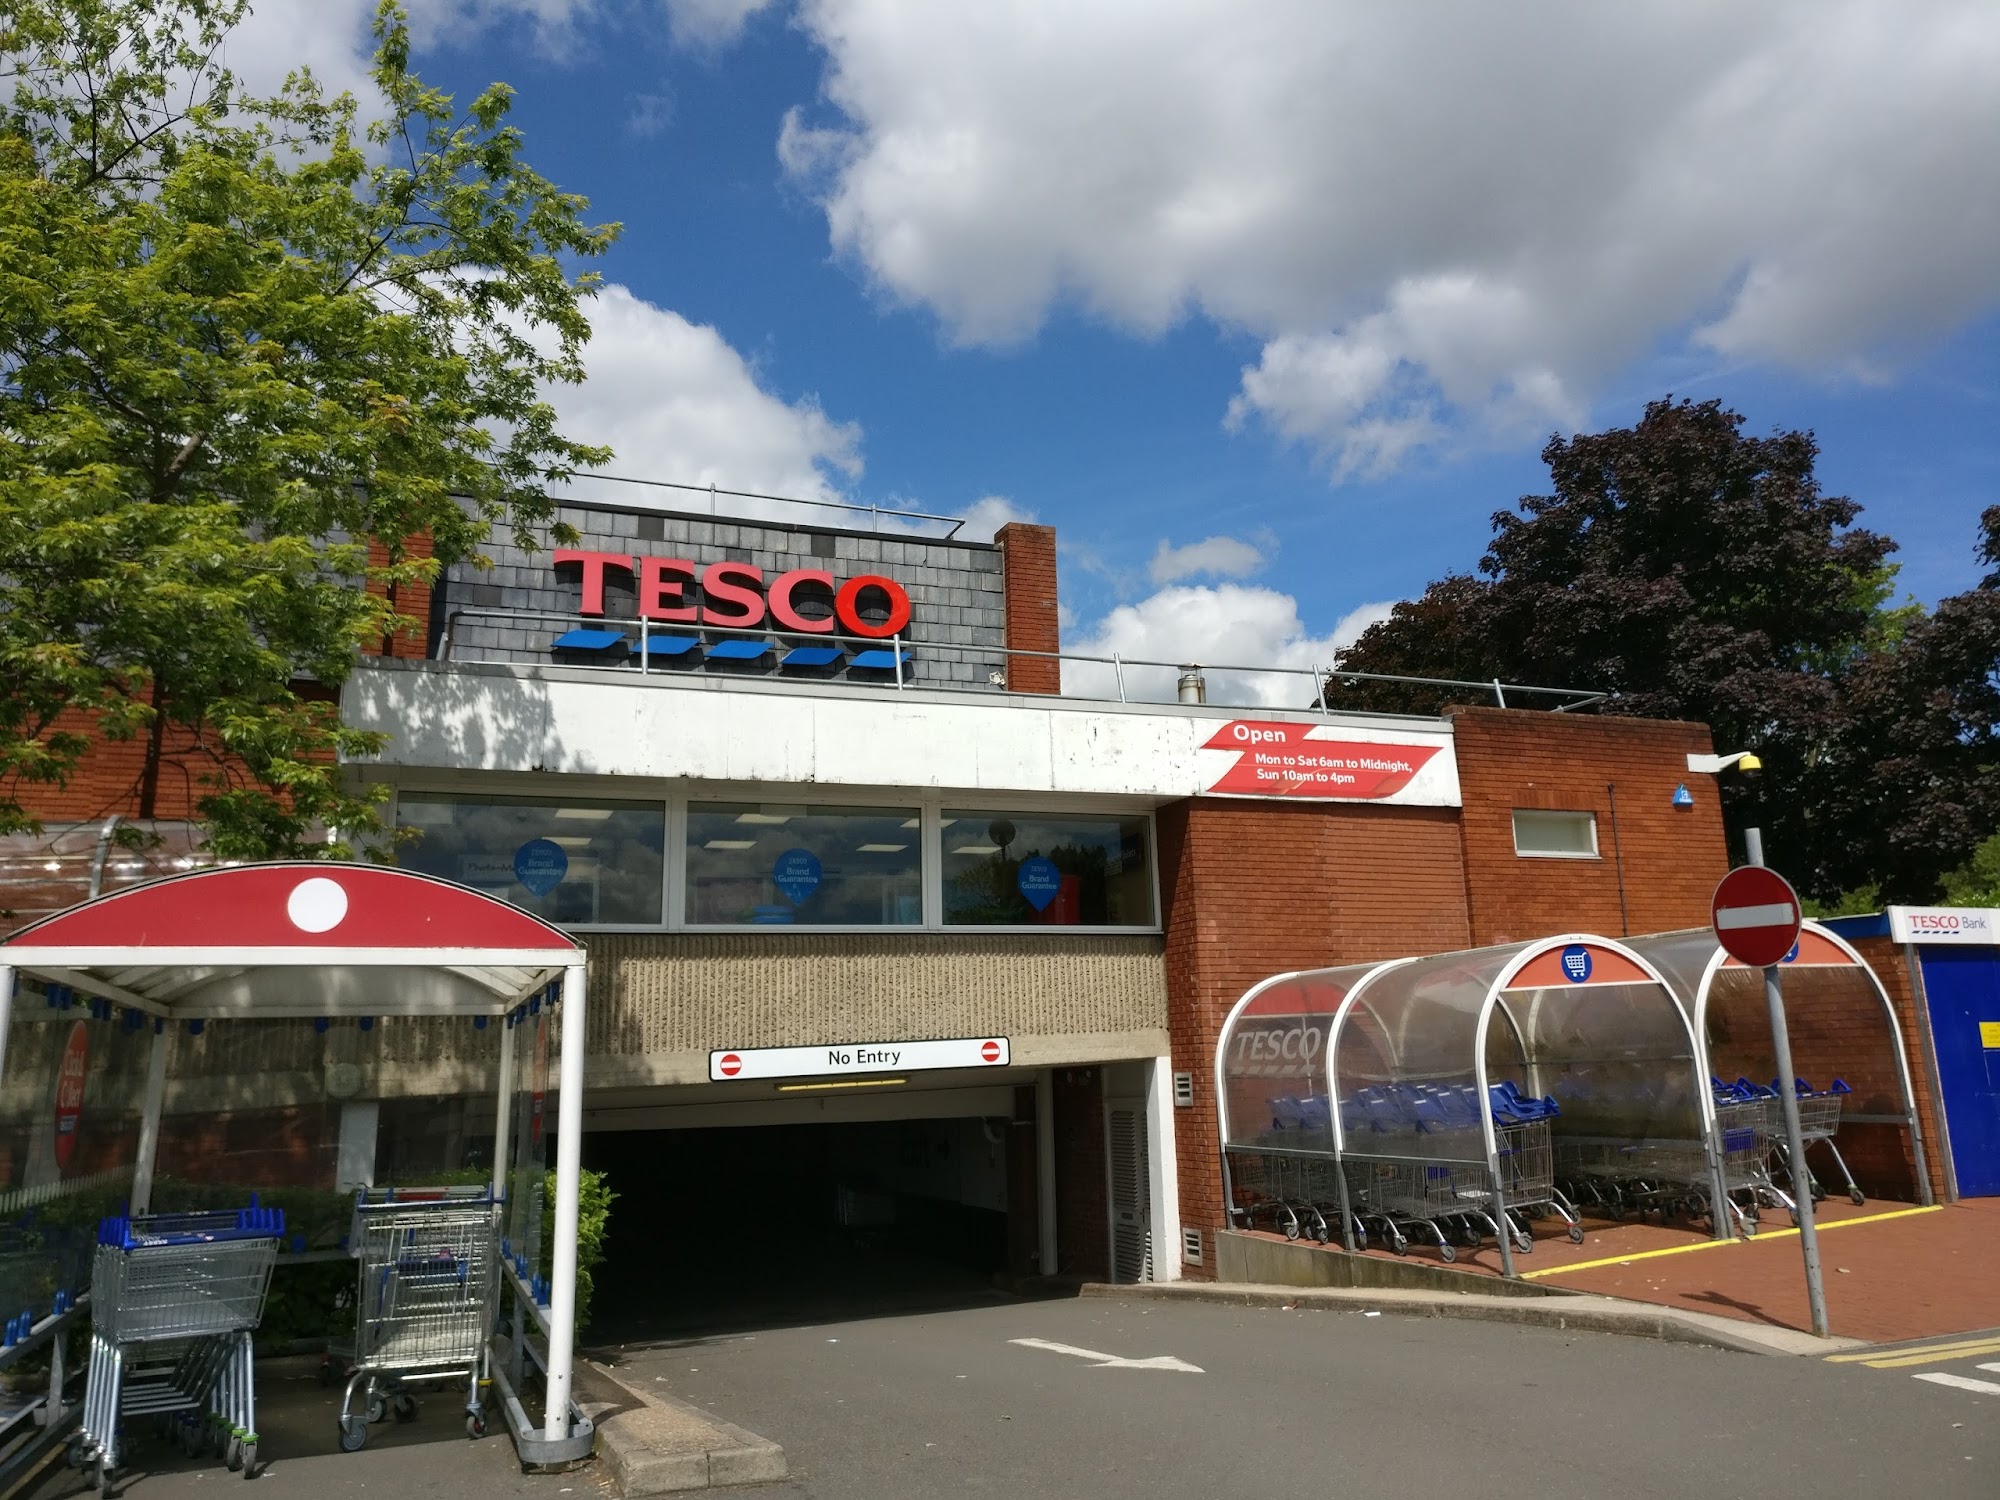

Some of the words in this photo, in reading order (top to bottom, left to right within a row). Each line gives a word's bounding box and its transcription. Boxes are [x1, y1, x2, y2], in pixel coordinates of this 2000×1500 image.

[553, 549, 911, 638] TESCO
[1233, 724, 1286, 744] Open
[1255, 753, 1280, 765] Mon
[1283, 755, 1296, 766] to
[1298, 755, 1317, 767] Sat
[1319, 756, 1344, 768] 6am
[1346, 757, 1358, 769] to
[1360, 758, 1413, 773] Midnight,
[1256, 769, 1279, 780] Sun
[1282, 770, 1314, 781] 10am
[1316, 771, 1328, 782] to
[1330, 772, 1355, 785] 4pm
[528, 859, 553, 867] Brand
[786, 867, 810, 875] Brand
[518, 867, 562, 876] Guarantee
[1022, 882, 1057, 890] Guarantee
[1909, 915, 1959, 929] TESCO
[1962, 916, 1987, 930] Bank
[1237, 1027, 1321, 1061] TESCO
[829, 1051, 850, 1065] No
[857, 1049, 901, 1066] Entry
